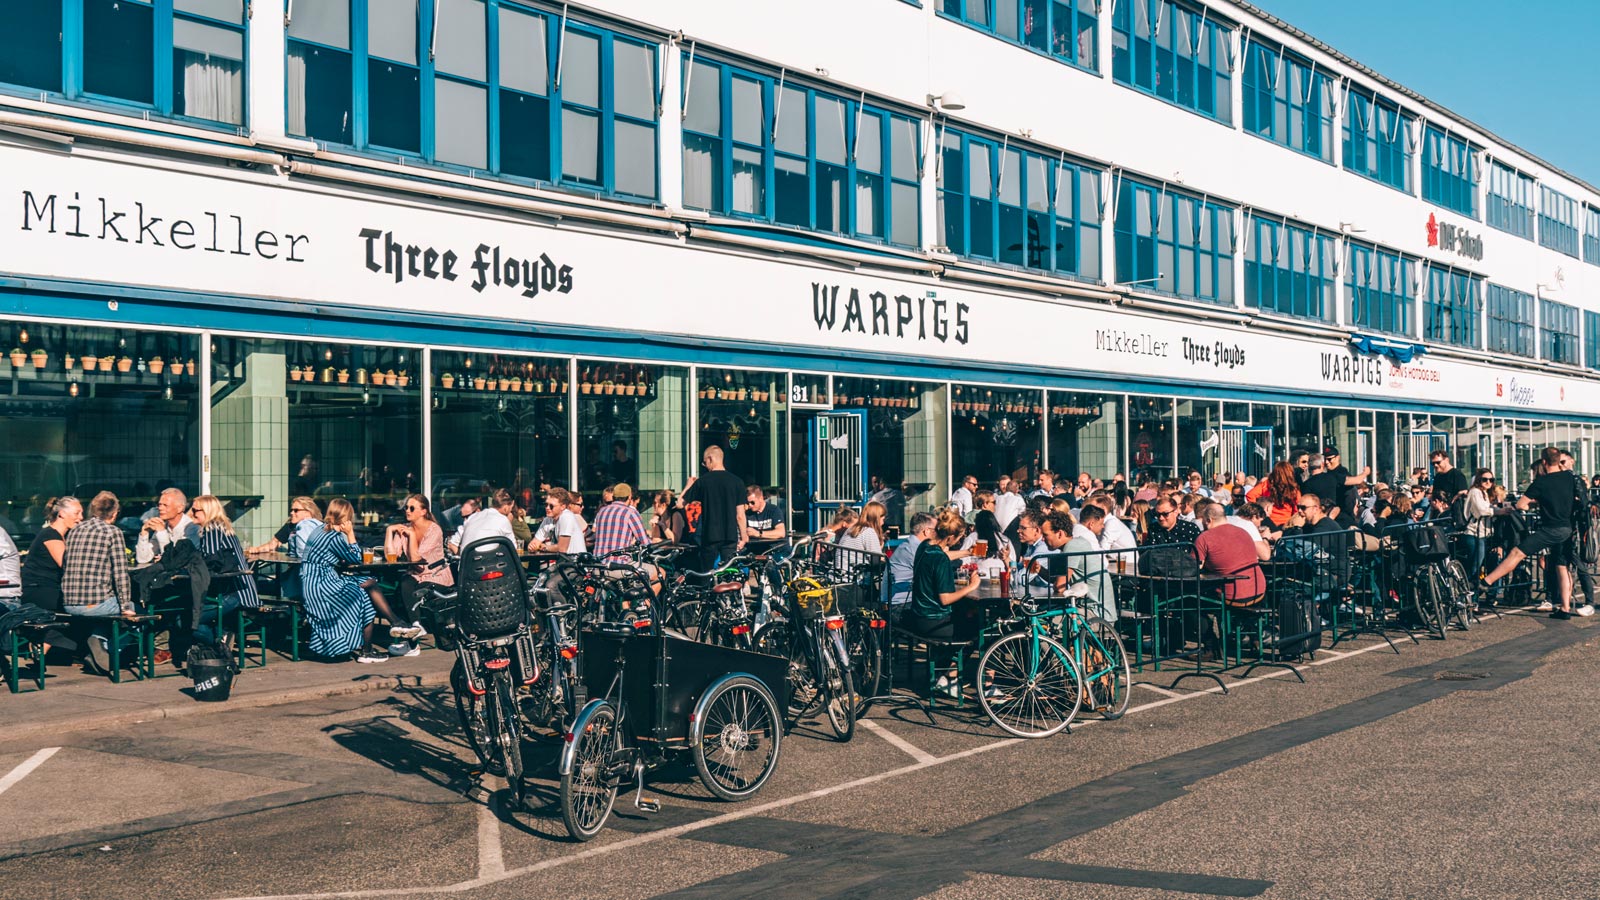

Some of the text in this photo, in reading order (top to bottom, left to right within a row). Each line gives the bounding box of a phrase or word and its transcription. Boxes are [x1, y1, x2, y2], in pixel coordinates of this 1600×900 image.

[22, 190, 309, 263] Mikkeller
[358, 227, 573, 299] Three Floyds
[811, 282, 970, 345] WARPIGS
[1096, 328, 1169, 358] Mikkeller
[1181, 336, 1245, 369] Three Floyds
[1320, 352, 1382, 387] WARPIGS
[793, 385, 808, 402] 31
